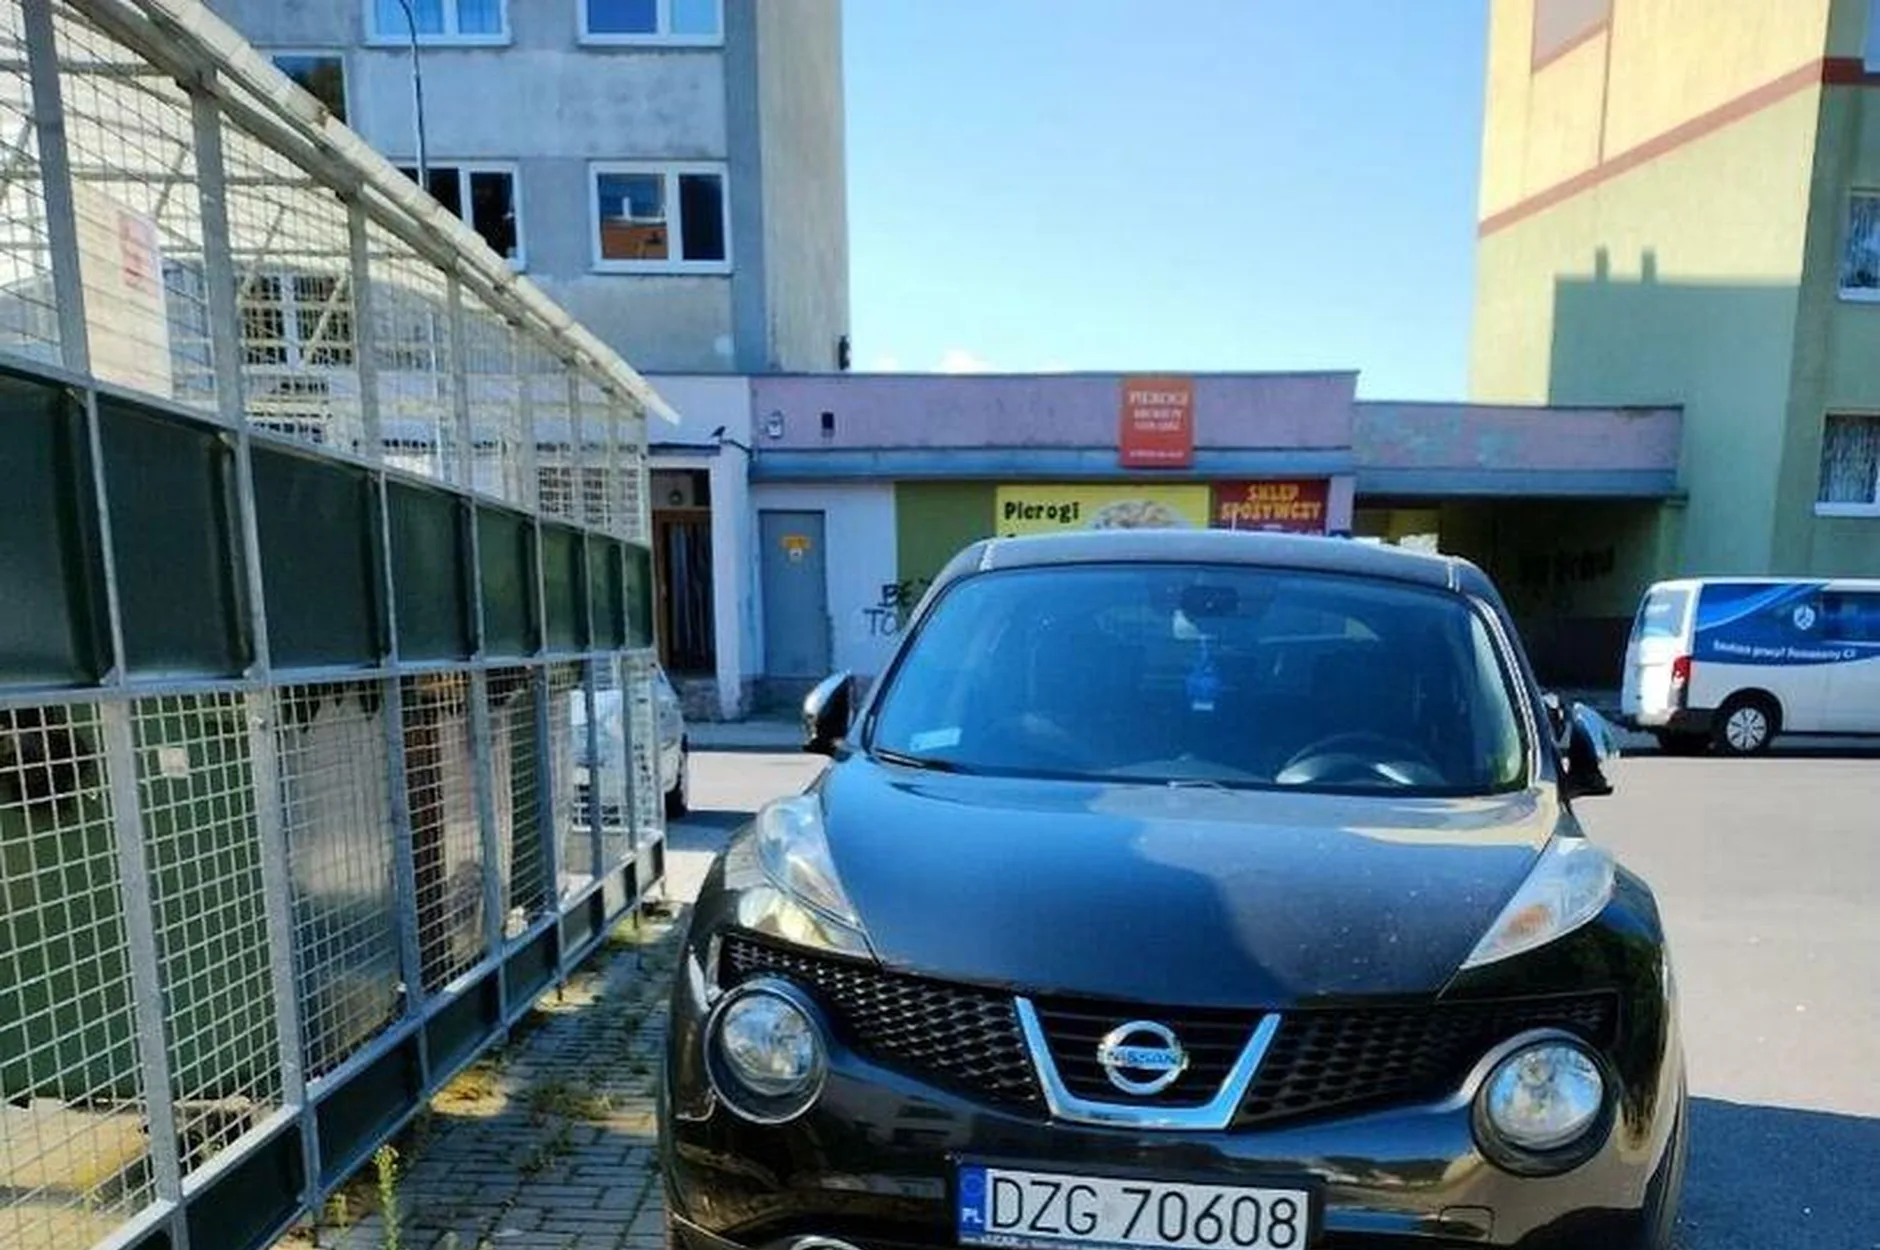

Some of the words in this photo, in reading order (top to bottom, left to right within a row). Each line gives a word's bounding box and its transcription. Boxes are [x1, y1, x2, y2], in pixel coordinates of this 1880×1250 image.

[1004, 501, 1080, 524] Pierogi
[1107, 1048, 1179, 1066] NISSAN
[961, 1207, 983, 1225] PL
[991, 1176, 1098, 1236] DZG
[1120, 1187, 1298, 1249] 70608
